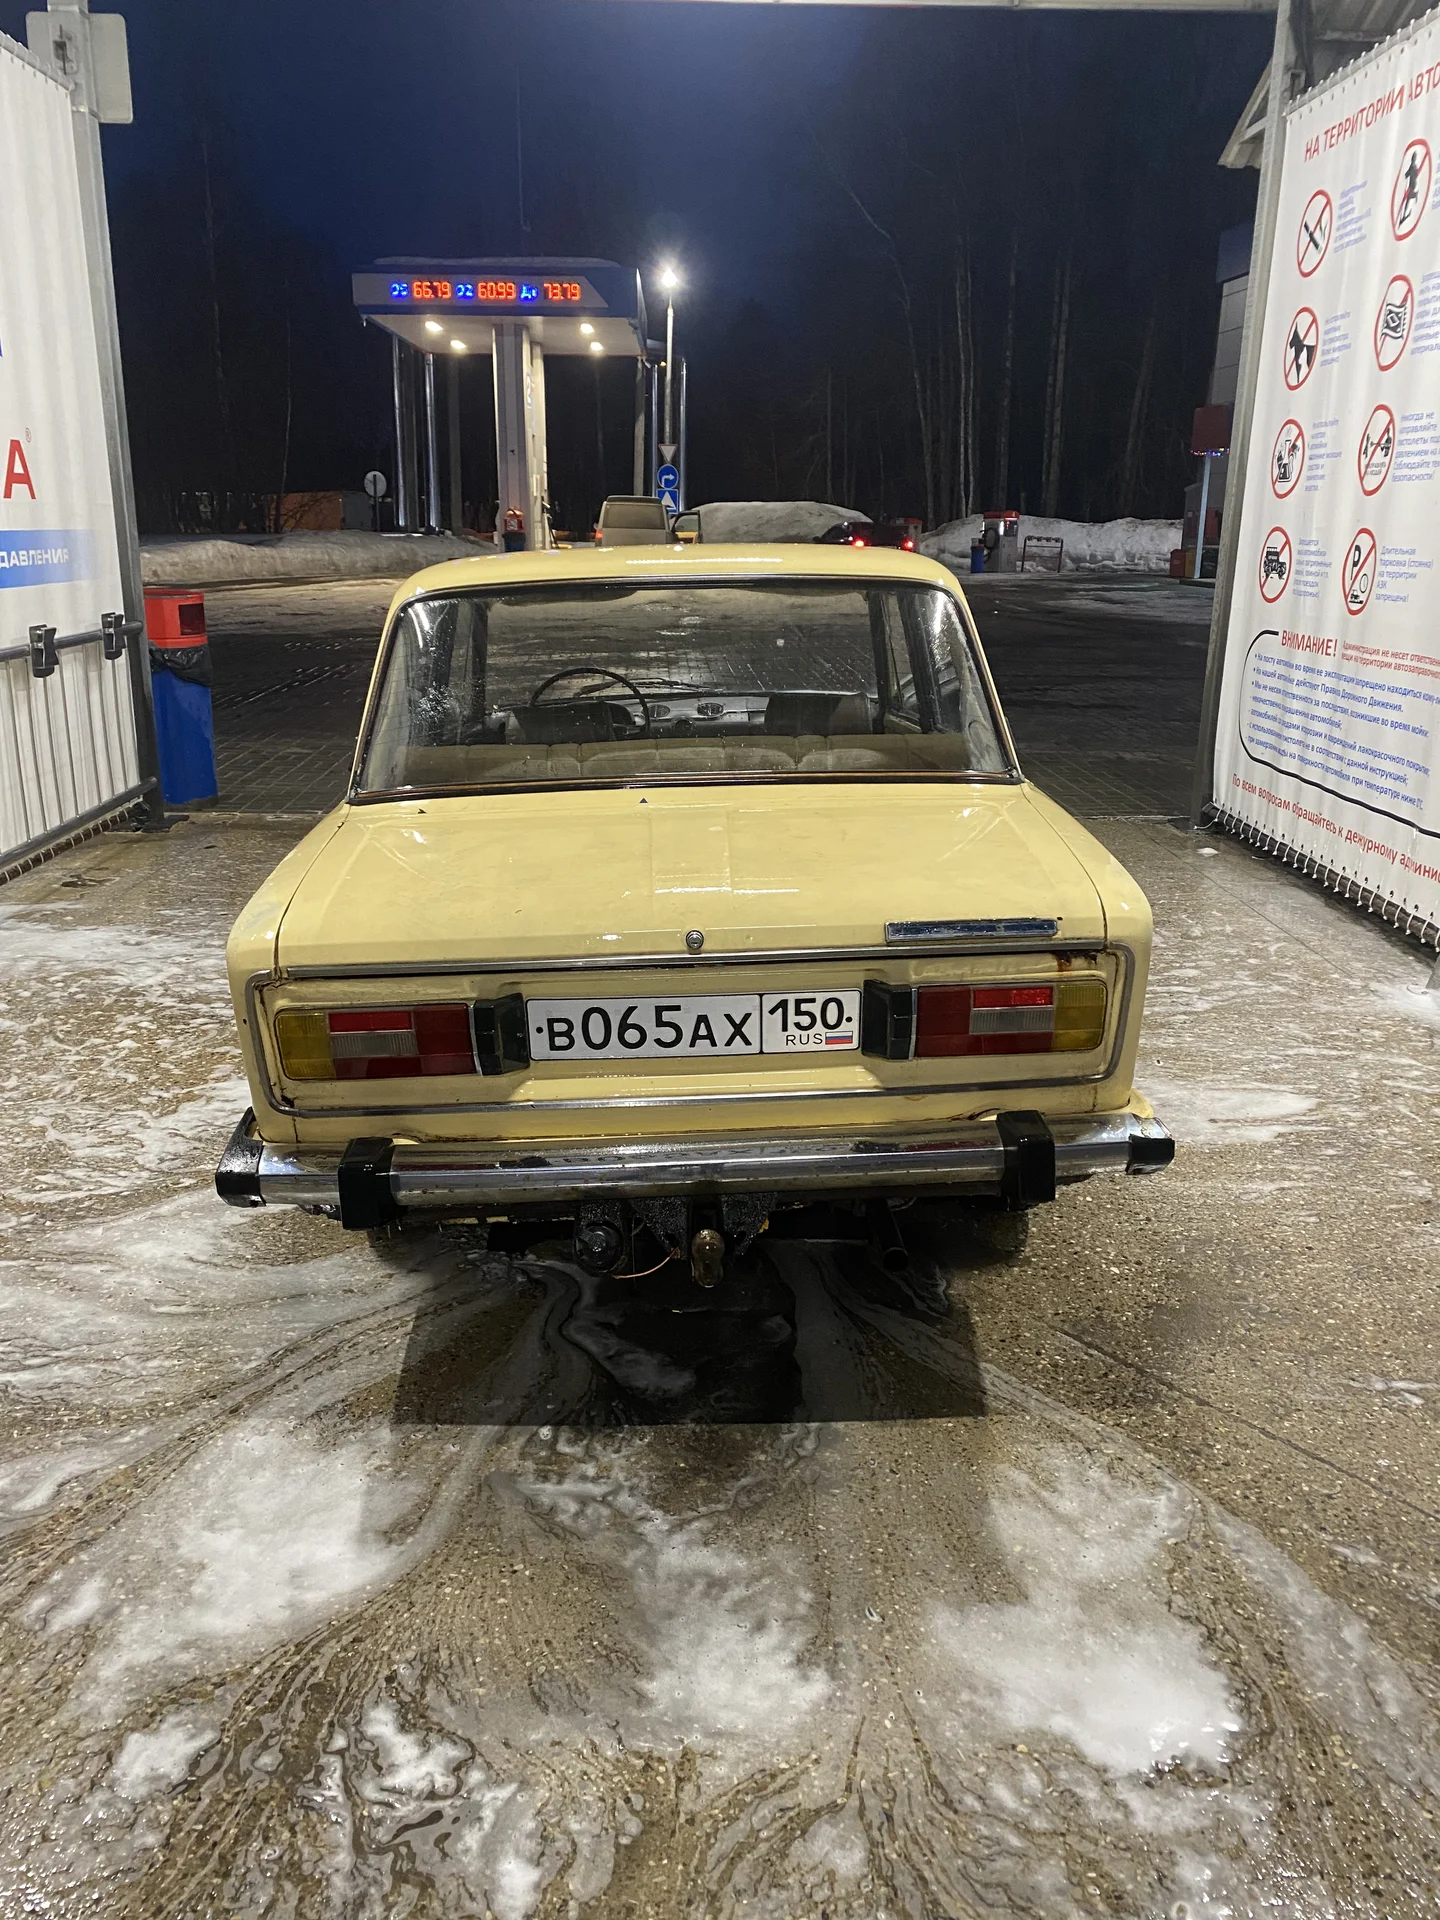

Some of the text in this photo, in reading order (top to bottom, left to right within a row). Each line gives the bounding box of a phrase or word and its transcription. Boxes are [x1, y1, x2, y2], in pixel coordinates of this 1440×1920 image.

[1304, 135, 1319, 163] НА
[1323, 84, 1405, 152] ТЕРРИТОРИИ
[413, 281, 451, 299] 66.79
[478, 282, 516, 299] 60.99
[544, 283, 580, 300] 73.79
[1281, 630, 1337, 657] ВНИМАНИЕ!
[1381, 649, 1389, 657] не
[1391, 651, 1409, 660] несет
[1368, 696, 1403, 712] Движения.
[1387, 685, 1422, 700] находиться
[1381, 718, 1388, 726] во
[1390, 720, 1410, 732] время
[1358, 745, 1405, 767] лакокрасочного
[1346, 759, 1369, 772] данной
[1369, 766, 1408, 786] инструкцией;
[1351, 776, 1363, 786] при
[1364, 780, 1400, 800] температуре
[1232, 773, 1240, 787] По
[1242, 780, 1256, 794] всем
[1258, 788, 1290, 811] вопросам
[1292, 802, 1336, 834] обращайтесь
[1338, 826, 1344, 837] к
[1345, 829, 1398, 865] дежурному
[768, 997, 845, 1033] 150
[547, 1004, 752, 1051] В065АХ
[786, 1033, 823, 1046] RUS
